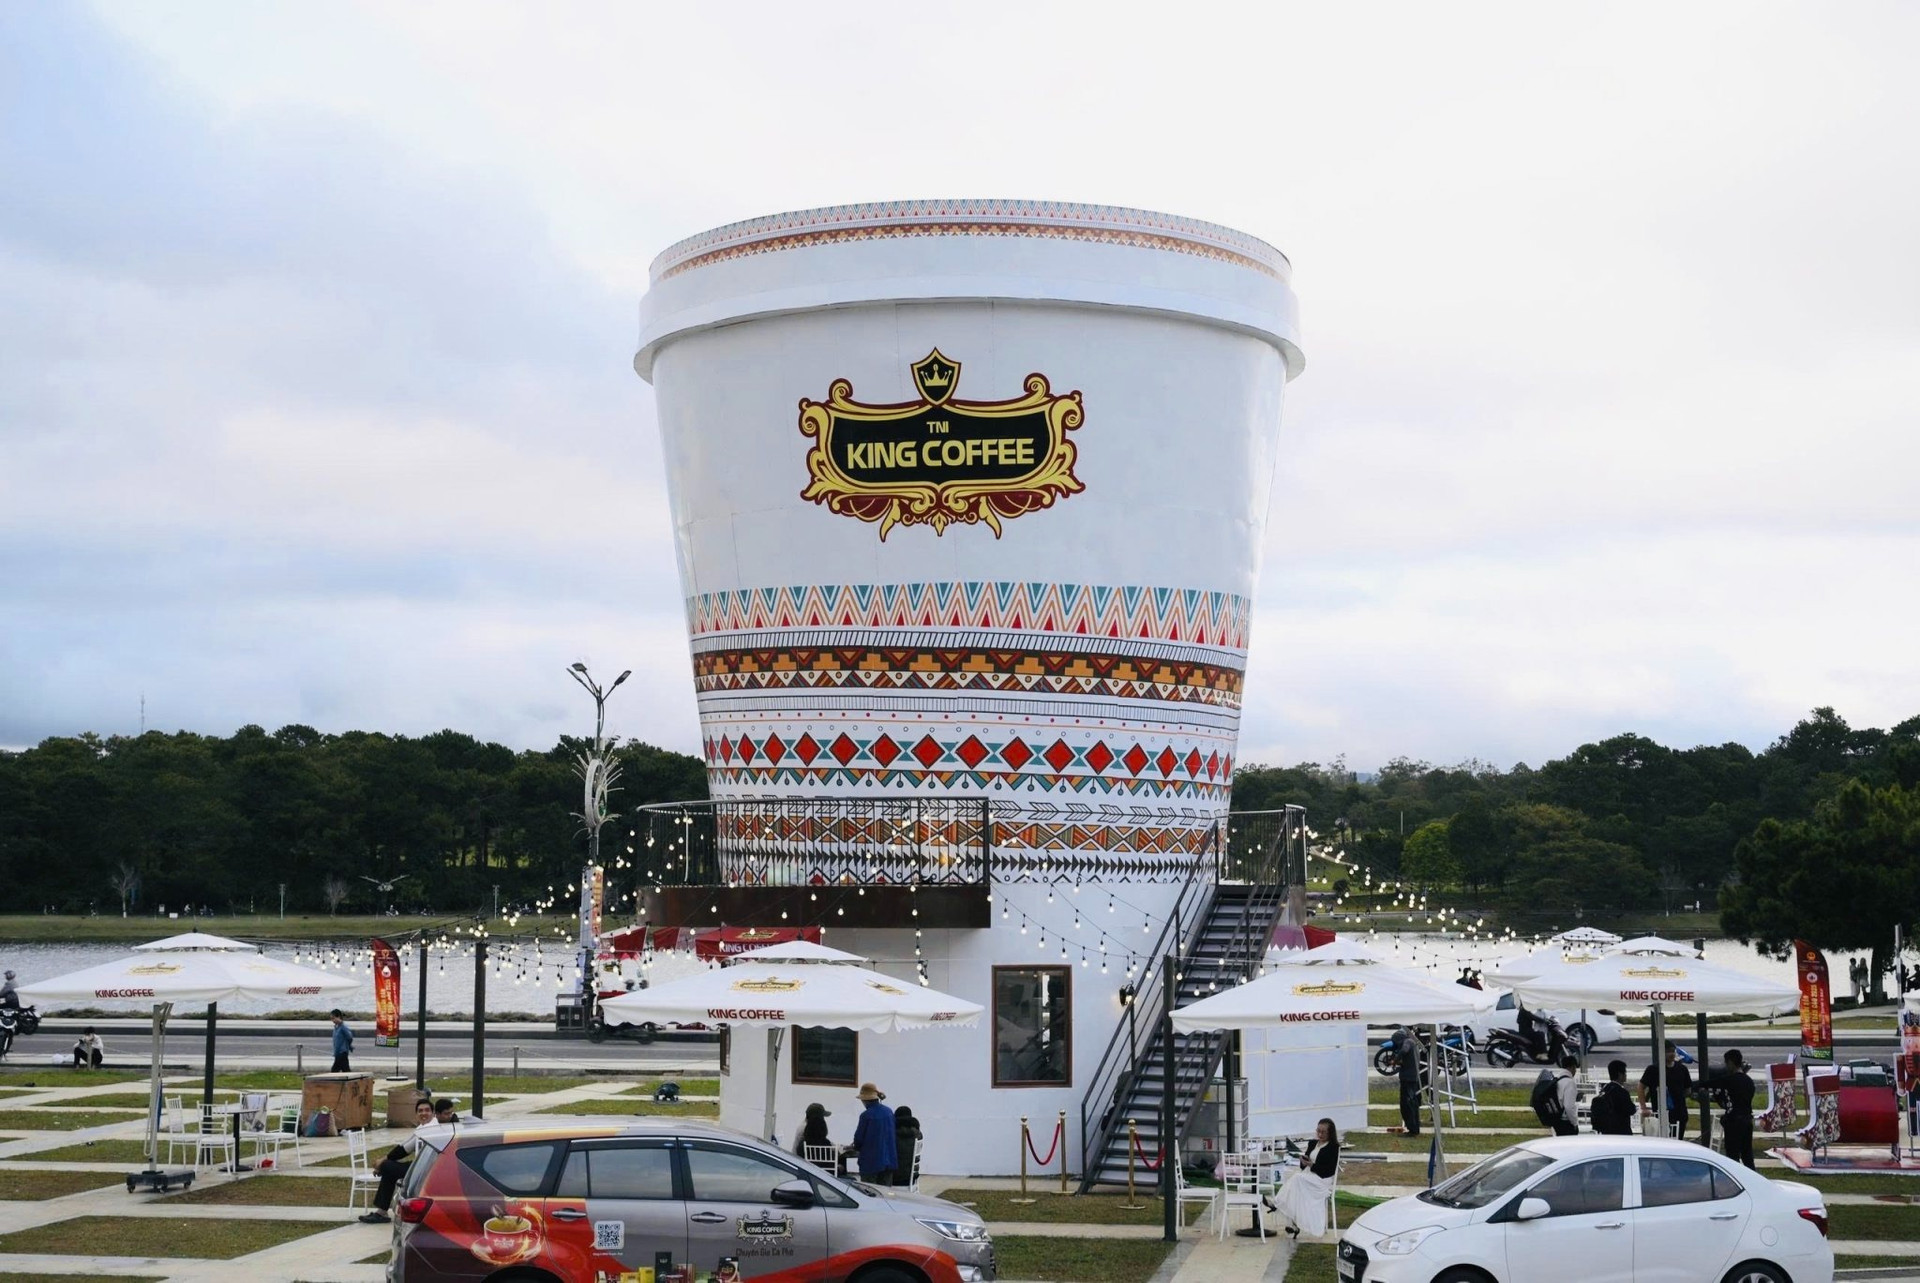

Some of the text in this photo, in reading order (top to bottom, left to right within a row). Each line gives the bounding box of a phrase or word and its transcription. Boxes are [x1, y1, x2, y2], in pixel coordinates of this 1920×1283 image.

[926, 421, 949, 434] TNI
[847, 438, 1035, 469] KING COFFEE
[95, 989, 155, 998] KING COFFEE
[1620, 991, 1694, 1001] KING COFFEE
[707, 1008, 785, 1020] KING COFFEE
[1280, 1011, 1360, 1022] KING COFFEE
